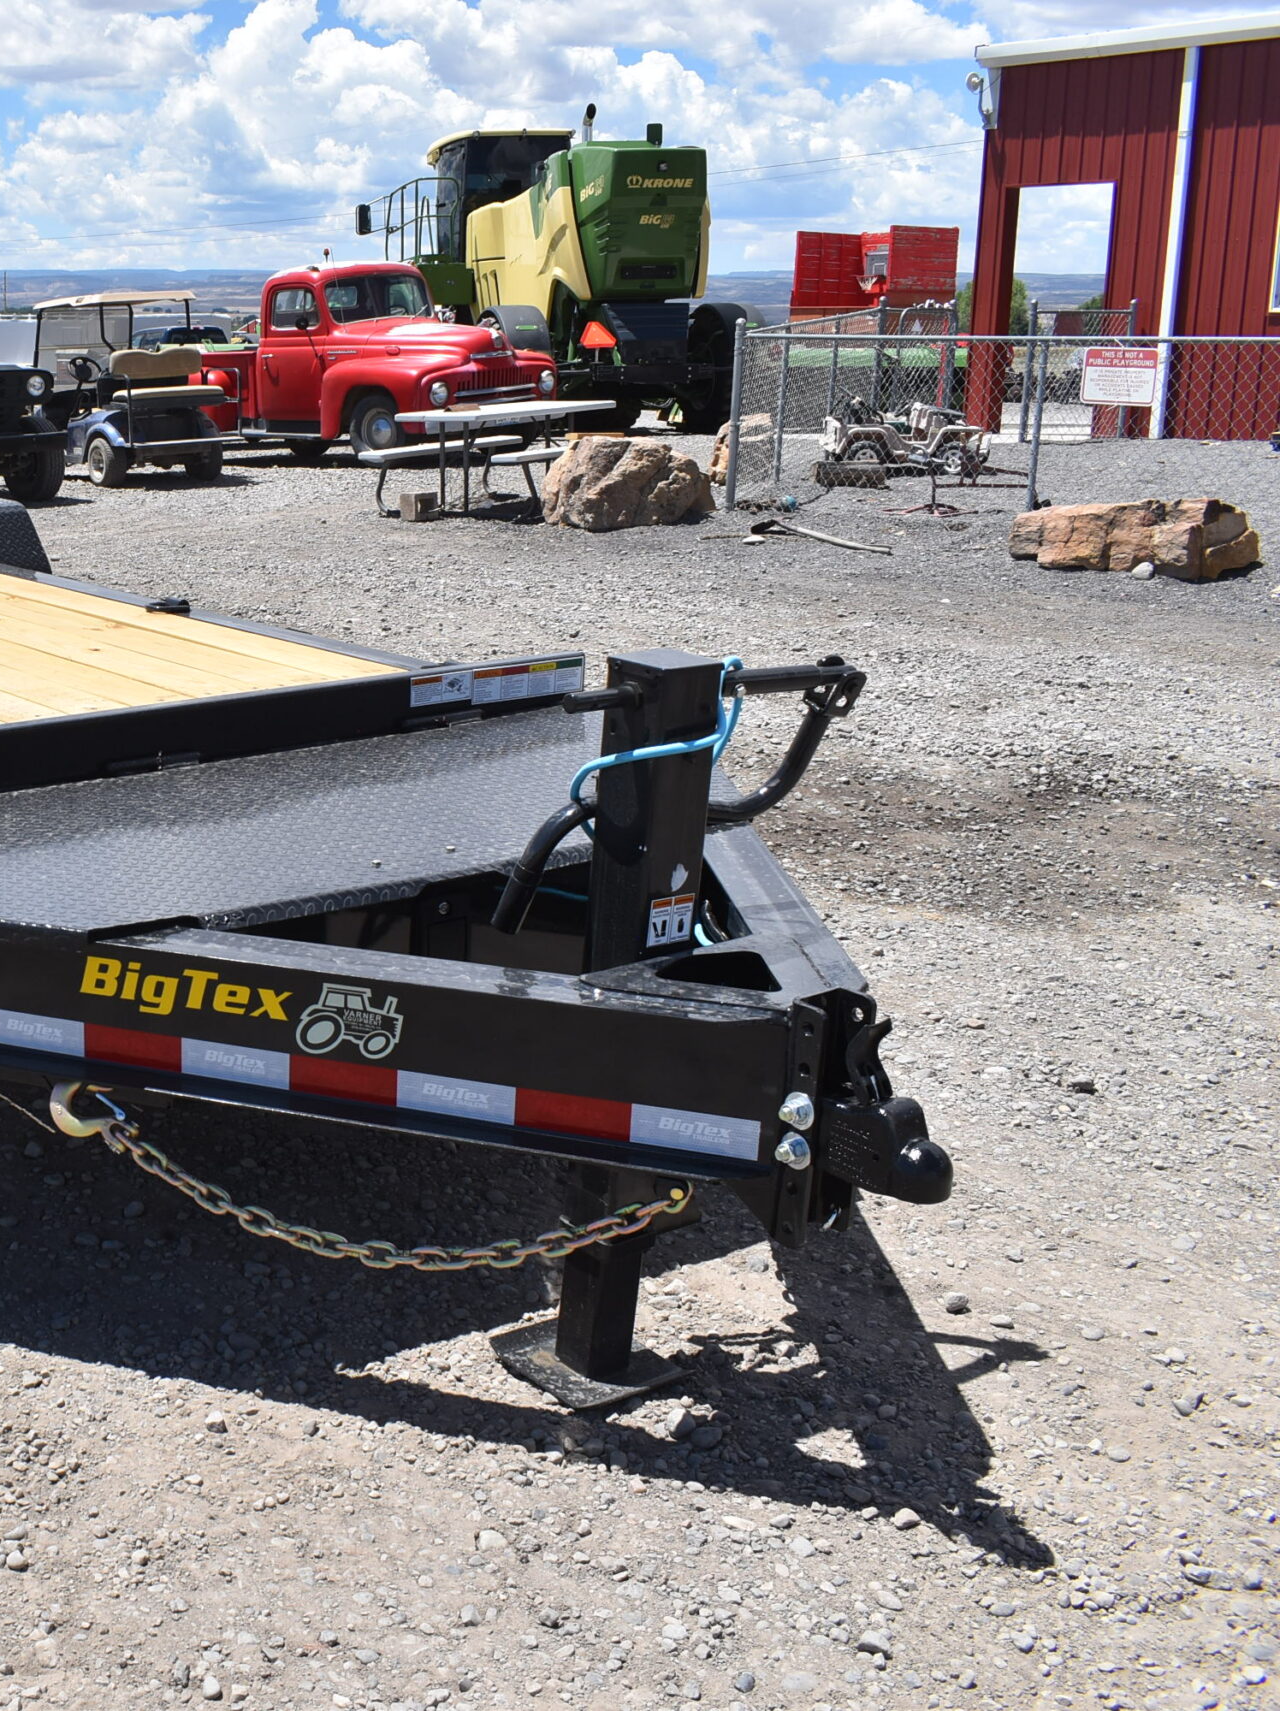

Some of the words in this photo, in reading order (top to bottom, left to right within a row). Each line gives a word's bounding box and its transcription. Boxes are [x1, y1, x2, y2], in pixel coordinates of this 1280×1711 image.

[642, 178, 693, 188] KRONE
[639, 214, 662, 225] BiG
[1088, 358, 1111, 366] PUBLIC
[1112, 359, 1155, 367] PLAYGROUND
[79, 955, 294, 1022] BigTex
[343, 1008, 382, 1021] VARNER
[6, 1018, 63, 1037] BigTex
[205, 1049, 267, 1068] BigTex
[422, 1082, 491, 1104] BigTex
[658, 1116, 732, 1138] BigTex
